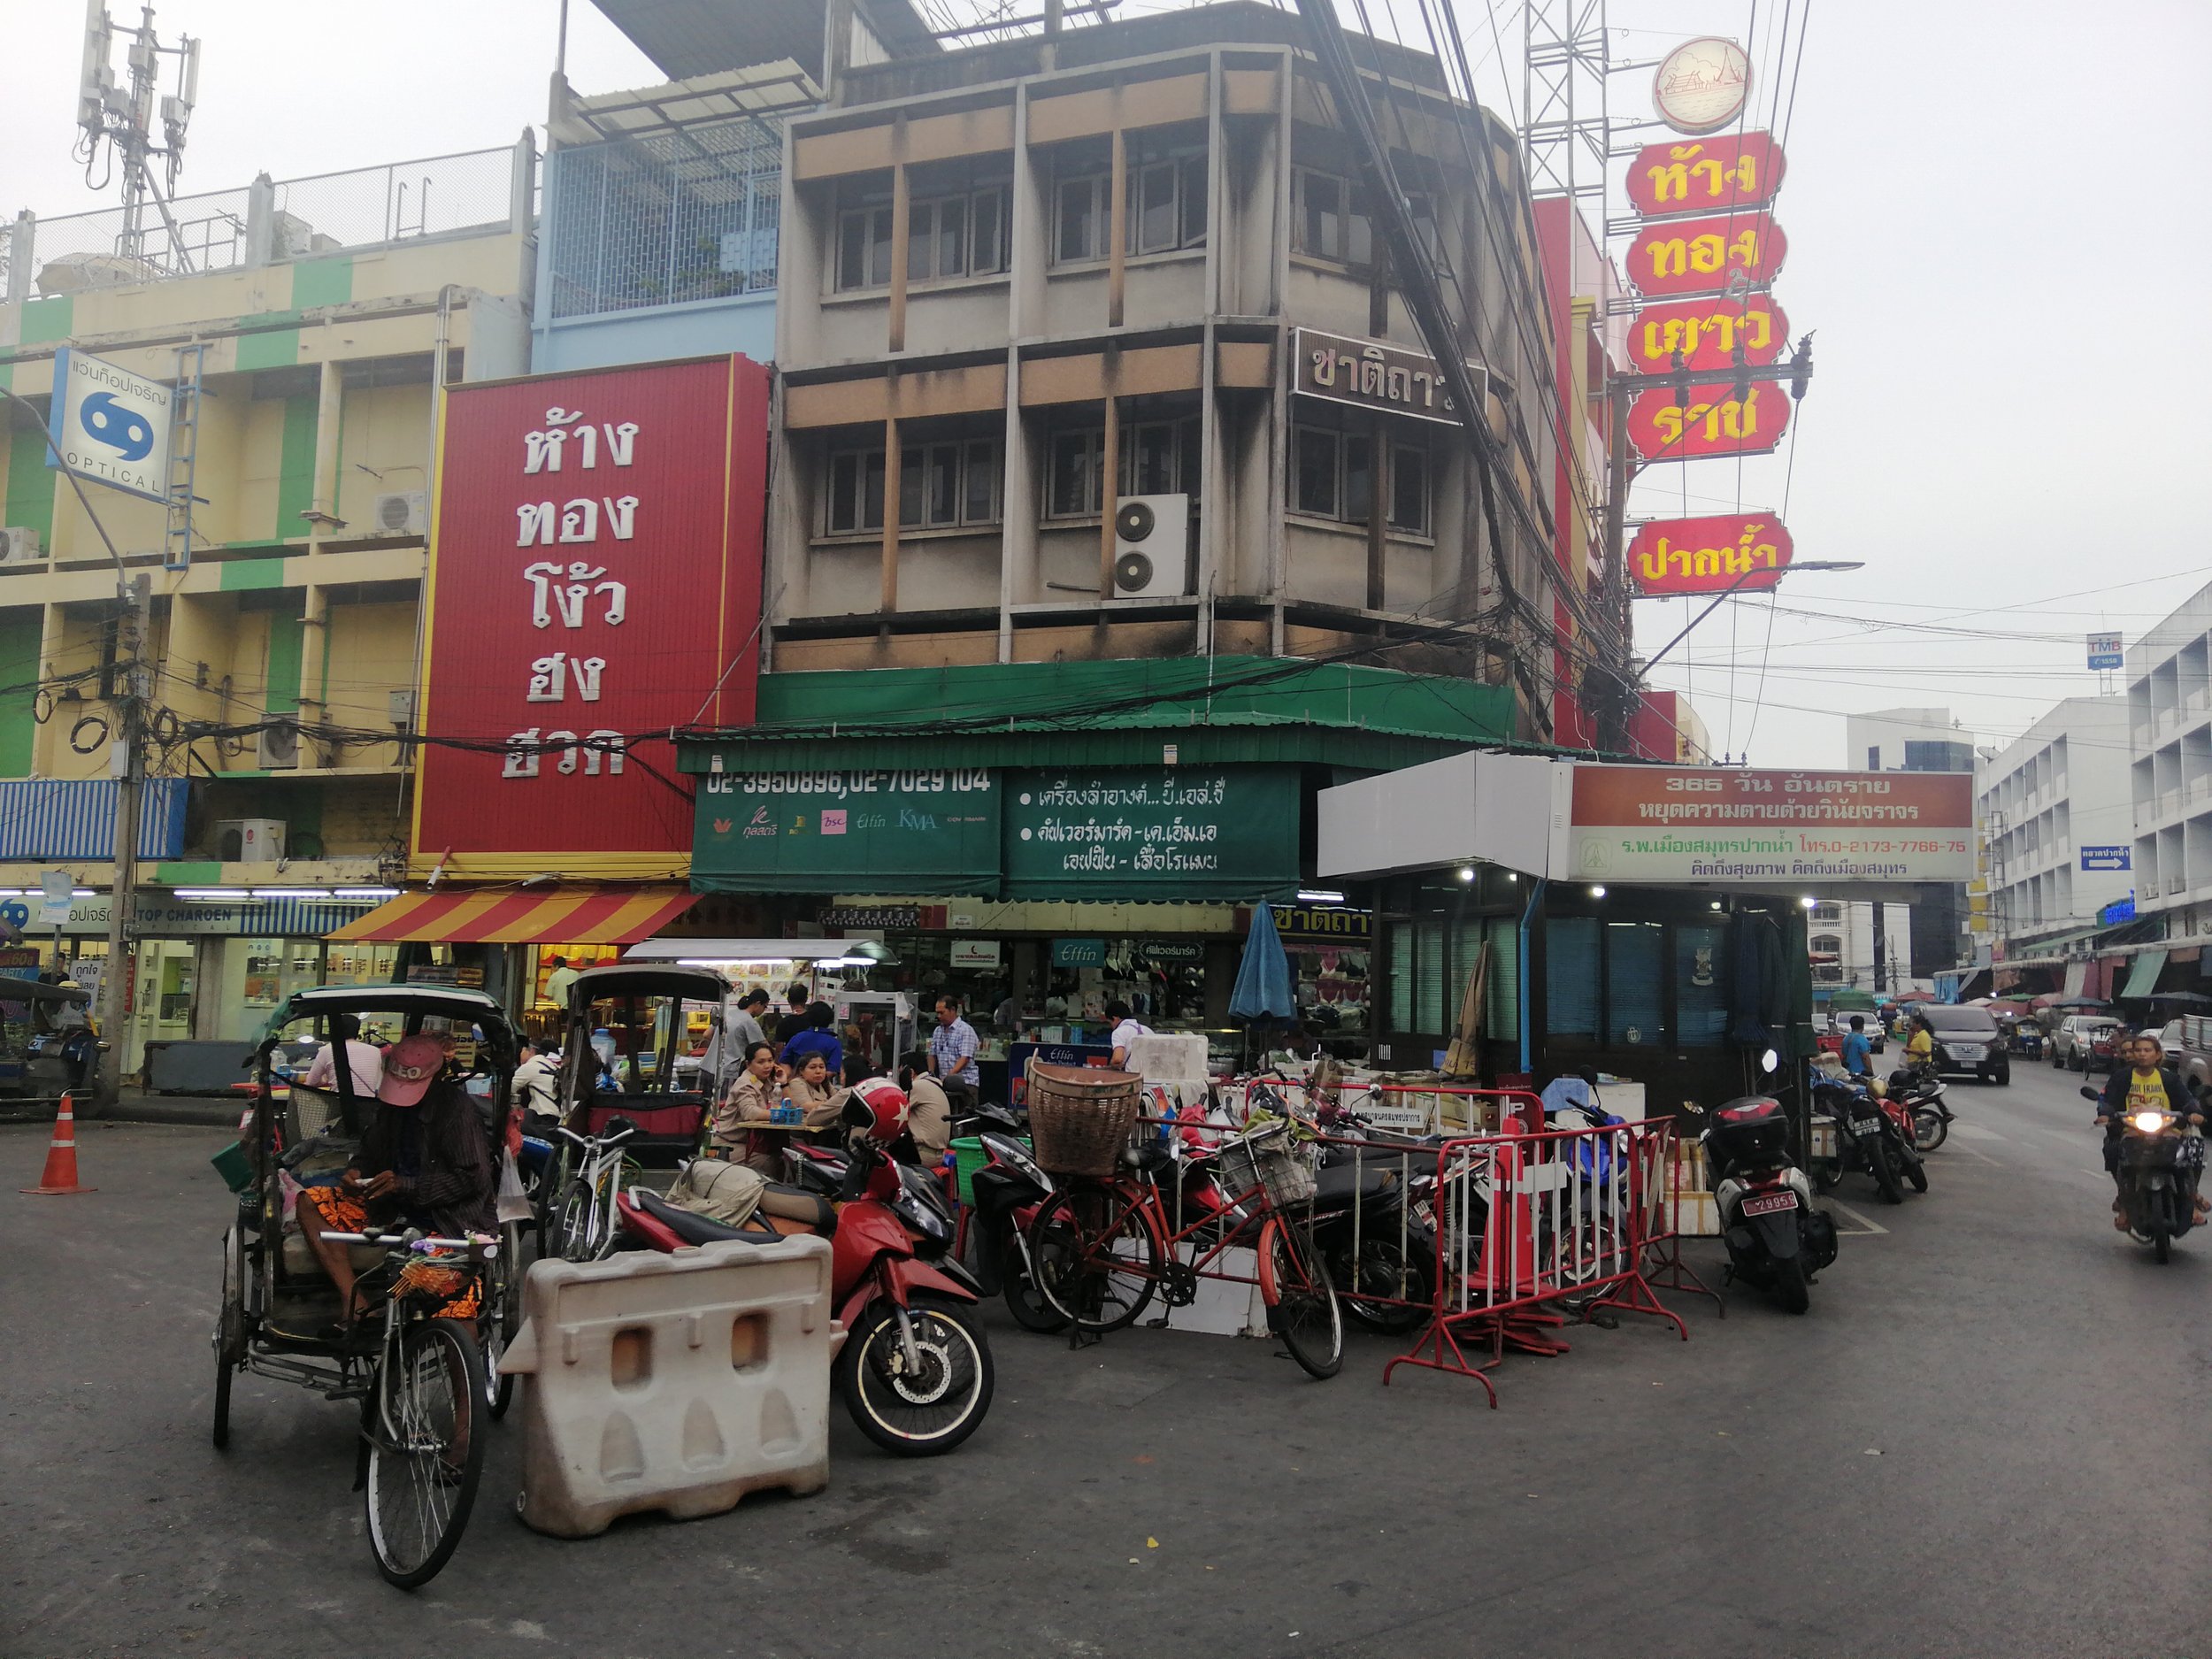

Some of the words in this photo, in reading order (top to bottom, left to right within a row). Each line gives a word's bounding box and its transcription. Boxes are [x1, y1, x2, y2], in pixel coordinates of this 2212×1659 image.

[1645, 229, 1760, 279] ทอง
[1644, 310, 1771, 361] เยาว
[524, 406, 640, 474] ห้าง
[1652, 387, 1760, 445] ราช
[66, 451, 160, 493] OPTICAL
[516, 495, 640, 547] ทอง
[1637, 523, 1778, 580] ปากน้ำ
[524, 561, 626, 629] โง้ว
[2088, 638, 2121, 653] TMB
[526, 652, 607, 702] ฮง
[1665, 778, 1724, 792] 365
[1734, 772, 1773, 793] วัน
[1784, 772, 1891, 794] อันตราย
[895, 808, 941, 831] KMA
[1638, 797, 1919, 825] หยุดความตายด้วยวินัยจราจร
[137, 909, 163, 921] TOP
[167, 909, 232, 922] CHAROEN
